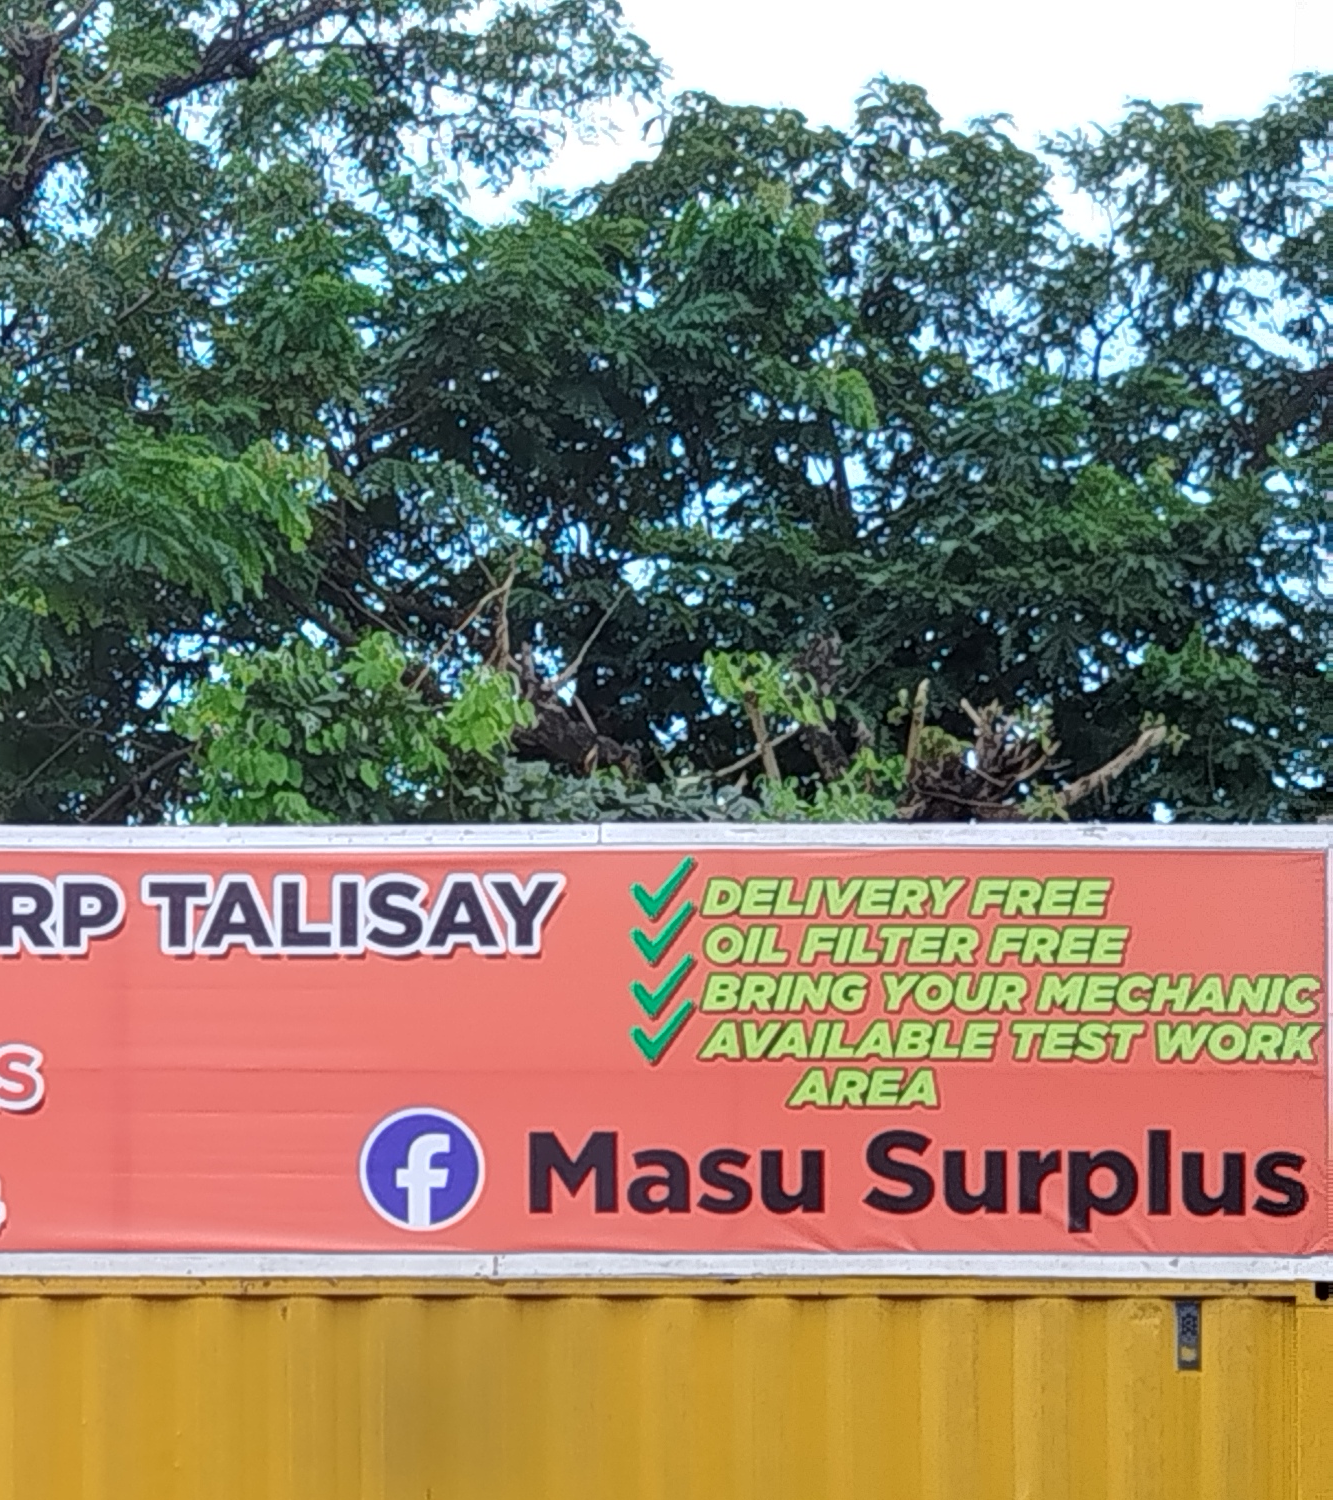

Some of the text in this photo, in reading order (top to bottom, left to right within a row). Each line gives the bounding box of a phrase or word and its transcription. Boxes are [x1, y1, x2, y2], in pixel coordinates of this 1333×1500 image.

[146, 877, 558, 952] TALISAY
[701, 877, 1110, 917] DELIVERY FREE
[704, 926, 1129, 965] OIL FILTER FREE
[700, 974, 1321, 1015] BRING YOUR MECHANIC
[697, 1020, 1322, 1061] AVAILABLE TEST WORK
[786, 1067, 939, 1108] AREA
[527, 1130, 827, 1216] Masu
[862, 1128, 1312, 1234] Surplus
